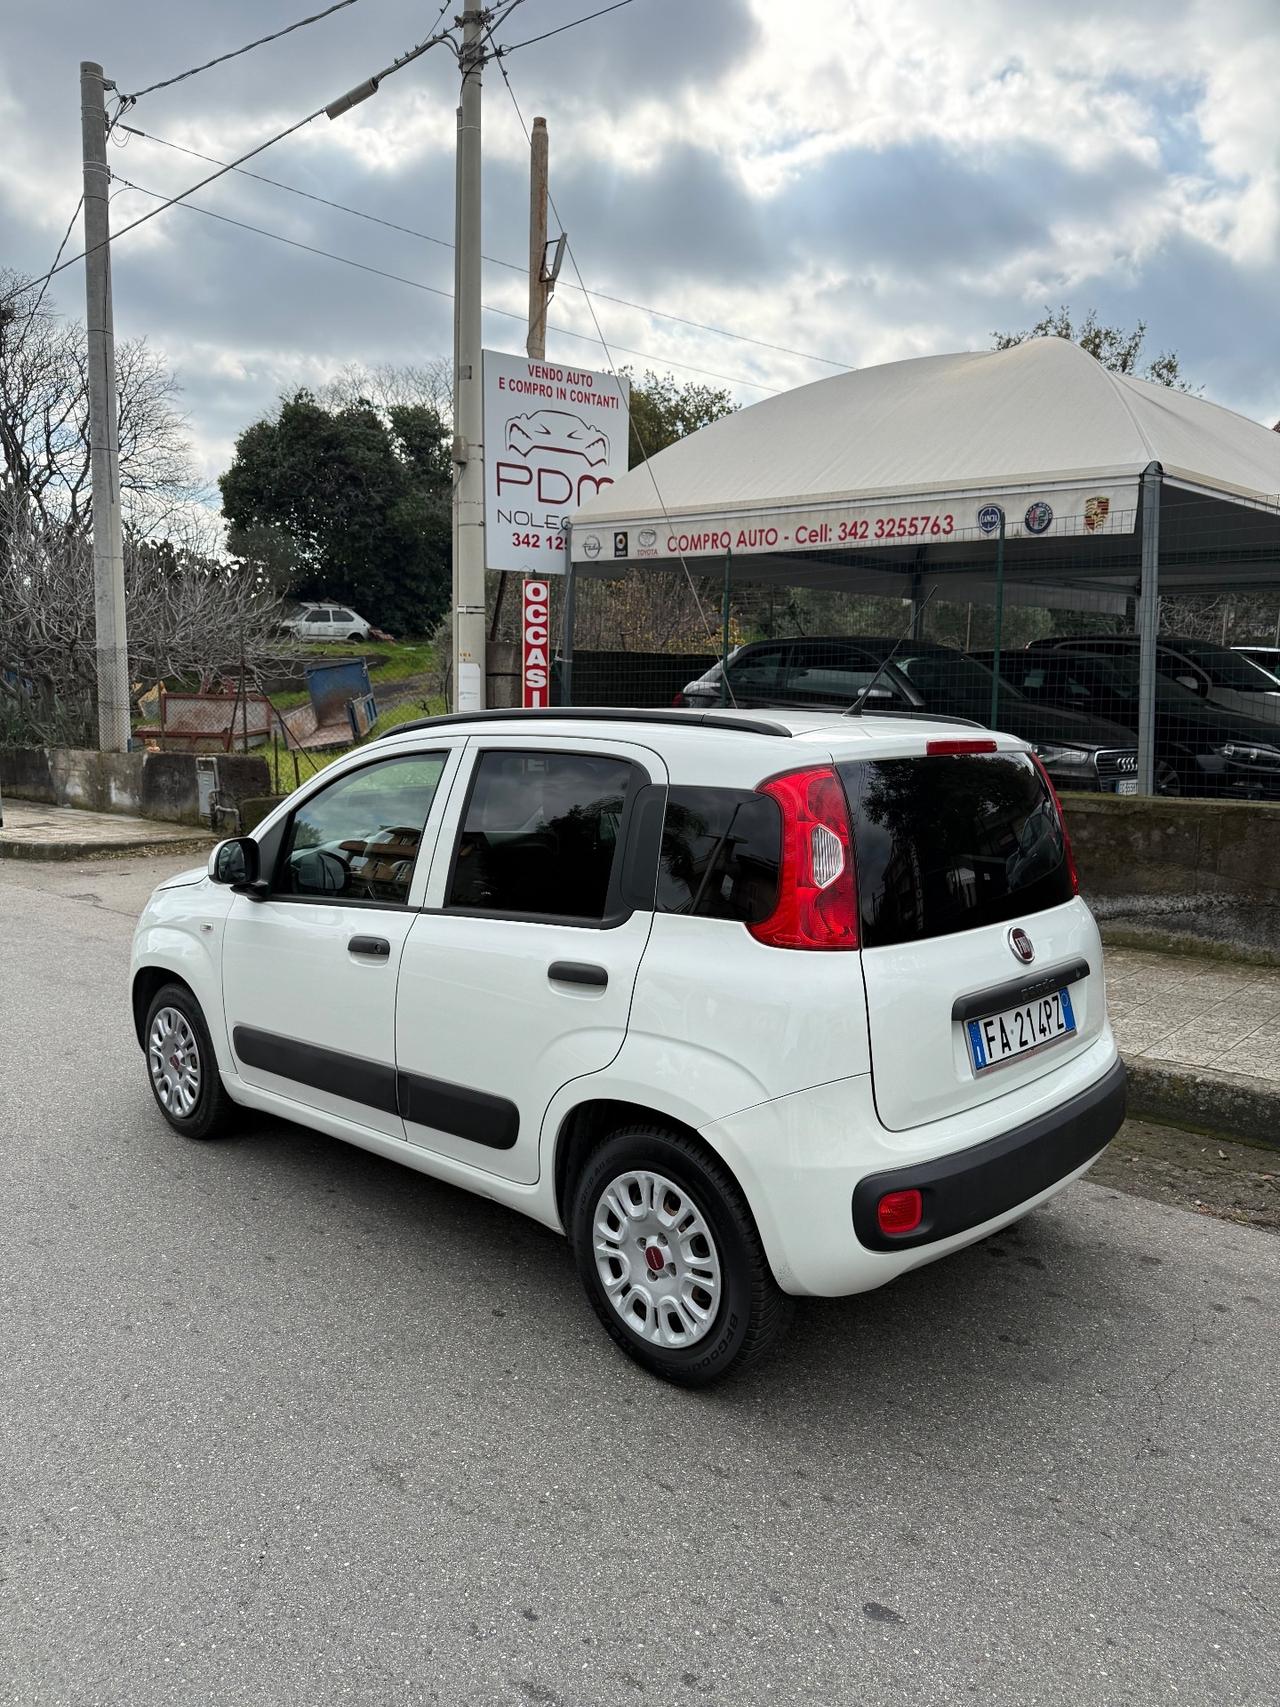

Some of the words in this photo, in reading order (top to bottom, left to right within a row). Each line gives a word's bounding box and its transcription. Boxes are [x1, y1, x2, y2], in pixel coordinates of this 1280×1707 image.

[528, 364, 563, 382] VENDO
[566, 372, 593, 388] AUTO
[498, 377, 505, 390] E
[509, 379, 553, 398] COMPRO
[556, 387, 567, 401] IN
[570, 390, 619, 410] CONTANTI
[512, 532, 541, 549] 342
[667, 531, 731, 552] COMPRO
[736, 528, 778, 548] AUTO
[795, 523, 833, 544] Cell:
[838, 520, 869, 541] 342
[874, 514, 954, 539] 3255763
[983, 1016, 1012, 1059] FA
